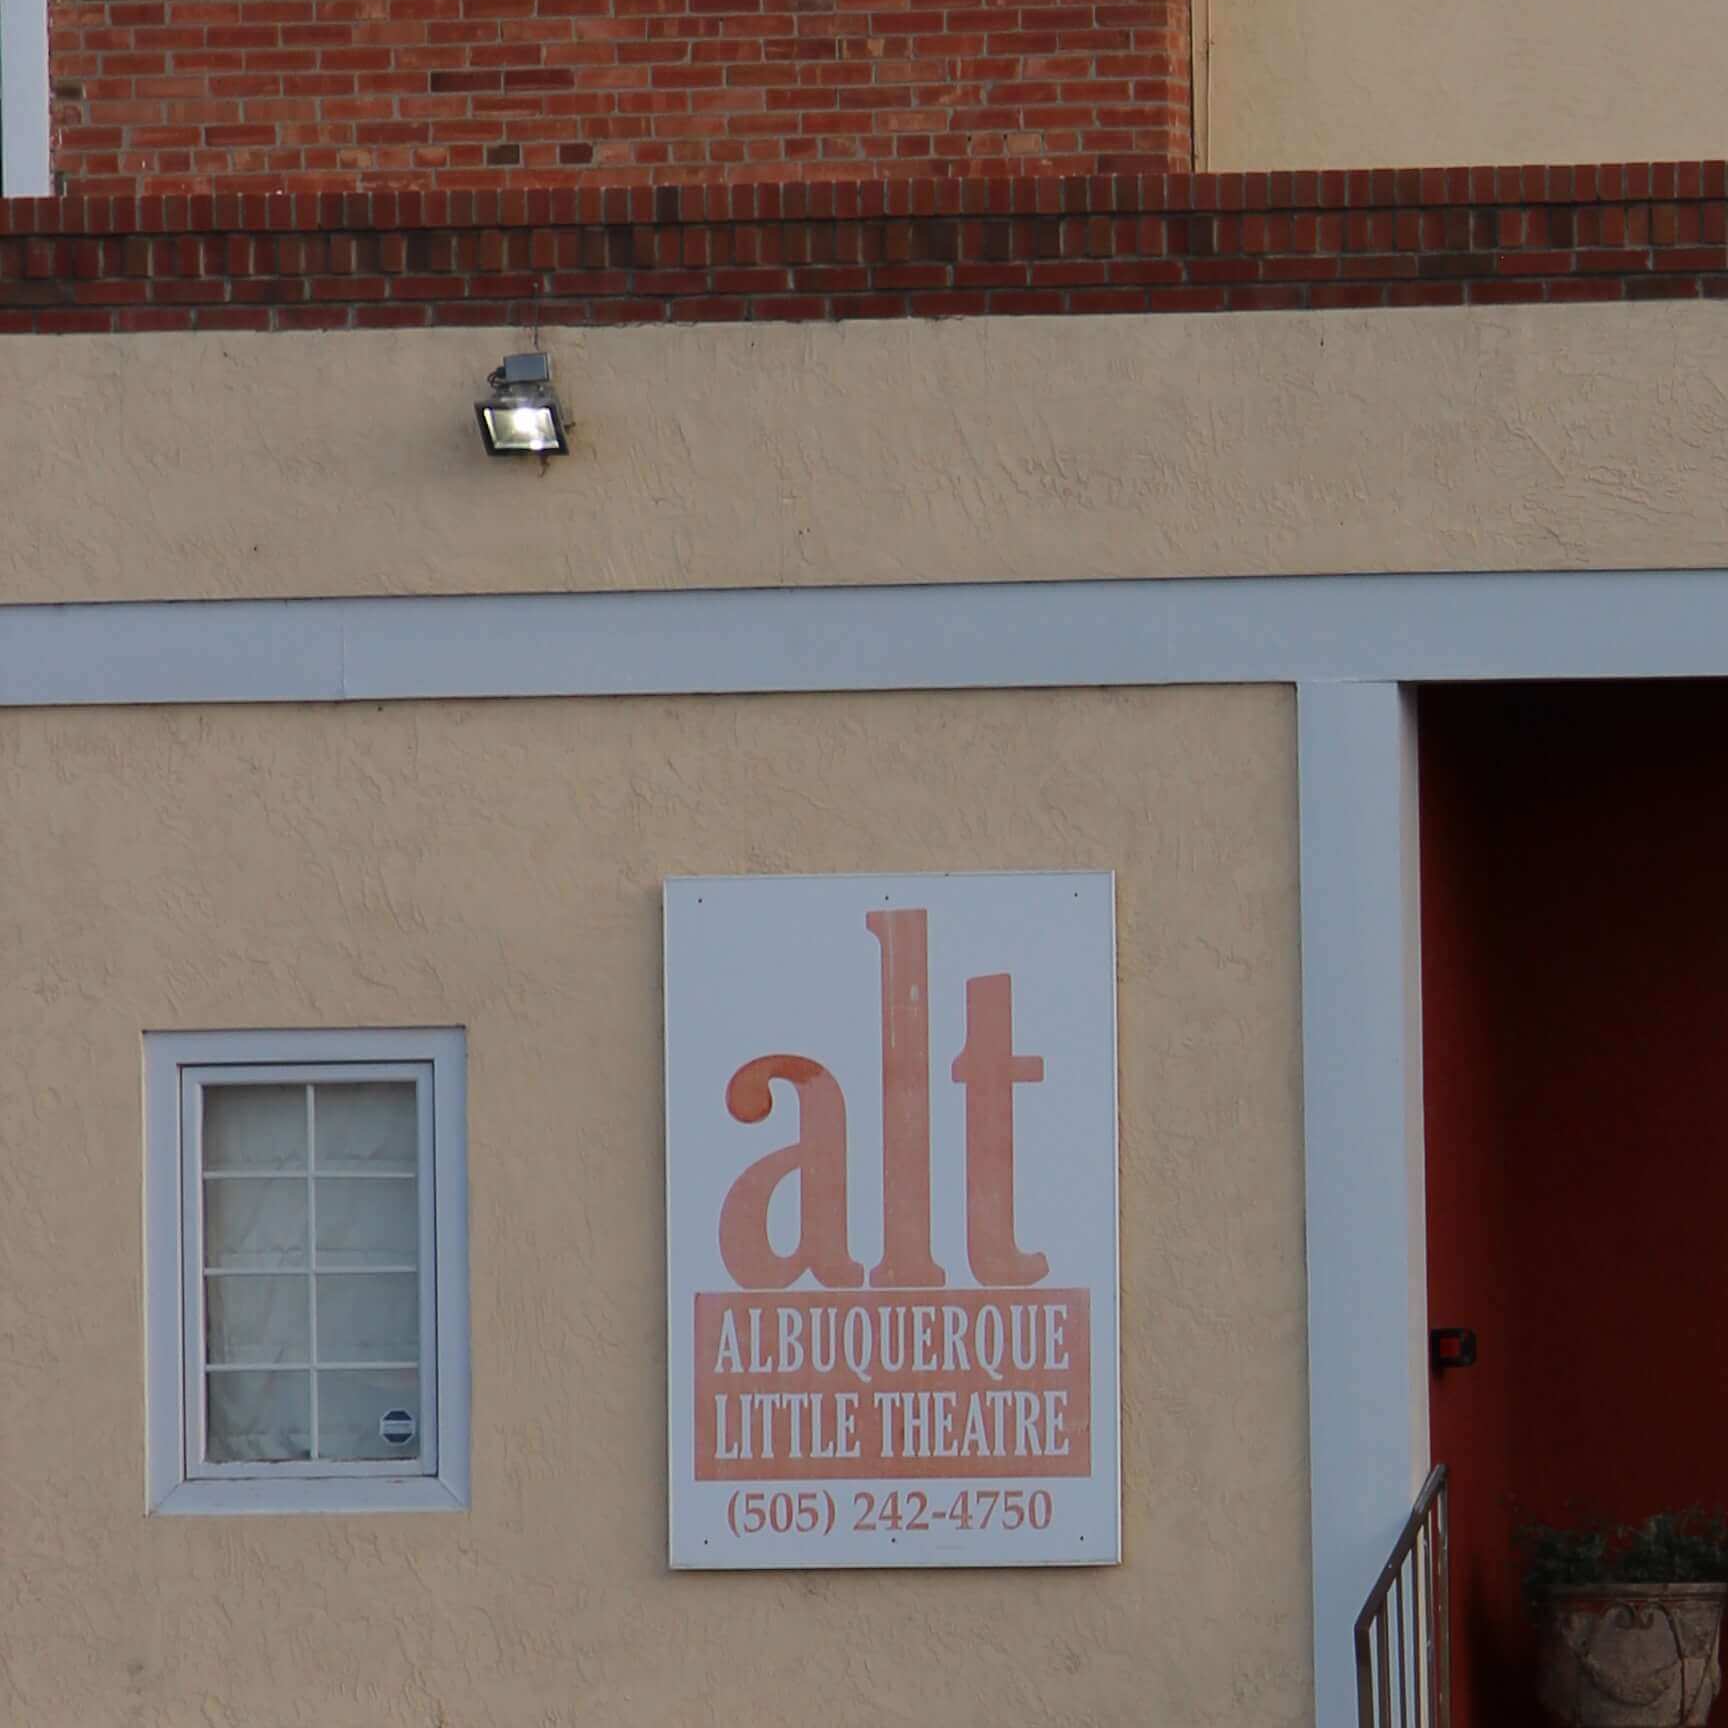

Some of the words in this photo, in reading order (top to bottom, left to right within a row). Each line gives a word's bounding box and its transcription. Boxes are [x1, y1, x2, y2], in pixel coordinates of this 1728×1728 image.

[719, 908, 1050, 1289] alt
[714, 1303, 1070, 1382] ALBUQUERQUE
[714, 1391, 861, 1461] LITTLE
[874, 1389, 1070, 1458] THEATRE
[727, 1489, 836, 1537] (505)
[853, 1488, 1052, 1532] 242-4750
